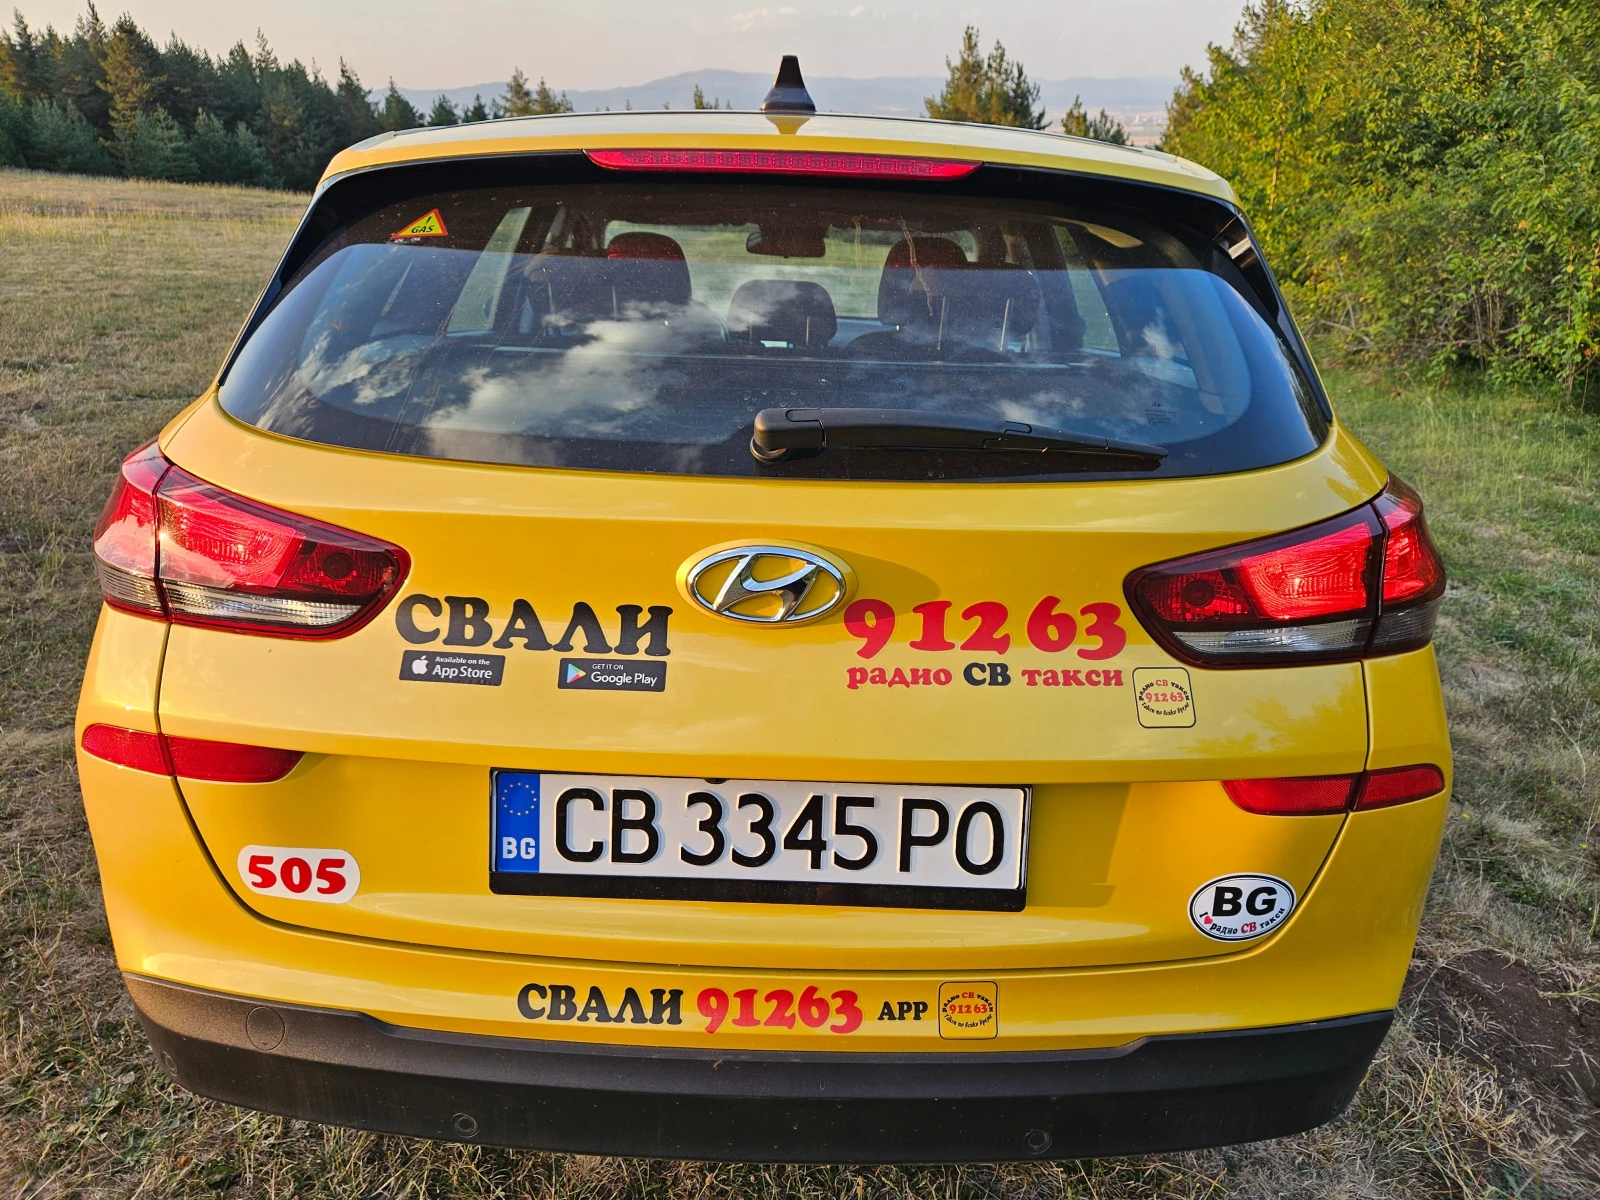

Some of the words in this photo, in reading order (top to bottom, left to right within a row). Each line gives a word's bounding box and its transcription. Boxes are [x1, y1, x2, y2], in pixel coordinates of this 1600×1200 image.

[411, 225, 434, 233] GAS
[395, 593, 673, 656] СВАЛИ
[432, 664, 458, 679] App
[459, 666, 493, 679] Store
[435, 656, 467, 664] Available
[590, 671, 633, 686] Google
[634, 673, 658, 687] Play
[846, 665, 953, 690] радио
[962, 662, 1012, 687] СВ
[1021, 667, 1124, 687] такси
[555, 788, 658, 864] CB
[680, 791, 878, 870] 3345
[502, 837, 536, 860] BG
[248, 855, 346, 895] 505
[1212, 886, 1278, 916] BG
[1209, 922, 1238, 935] радио
[1240, 921, 1257, 934] СВ
[1259, 907, 1285, 929] такси
[517, 983, 684, 1025] СВАЛИ
[697, 985, 863, 1035] 91263
